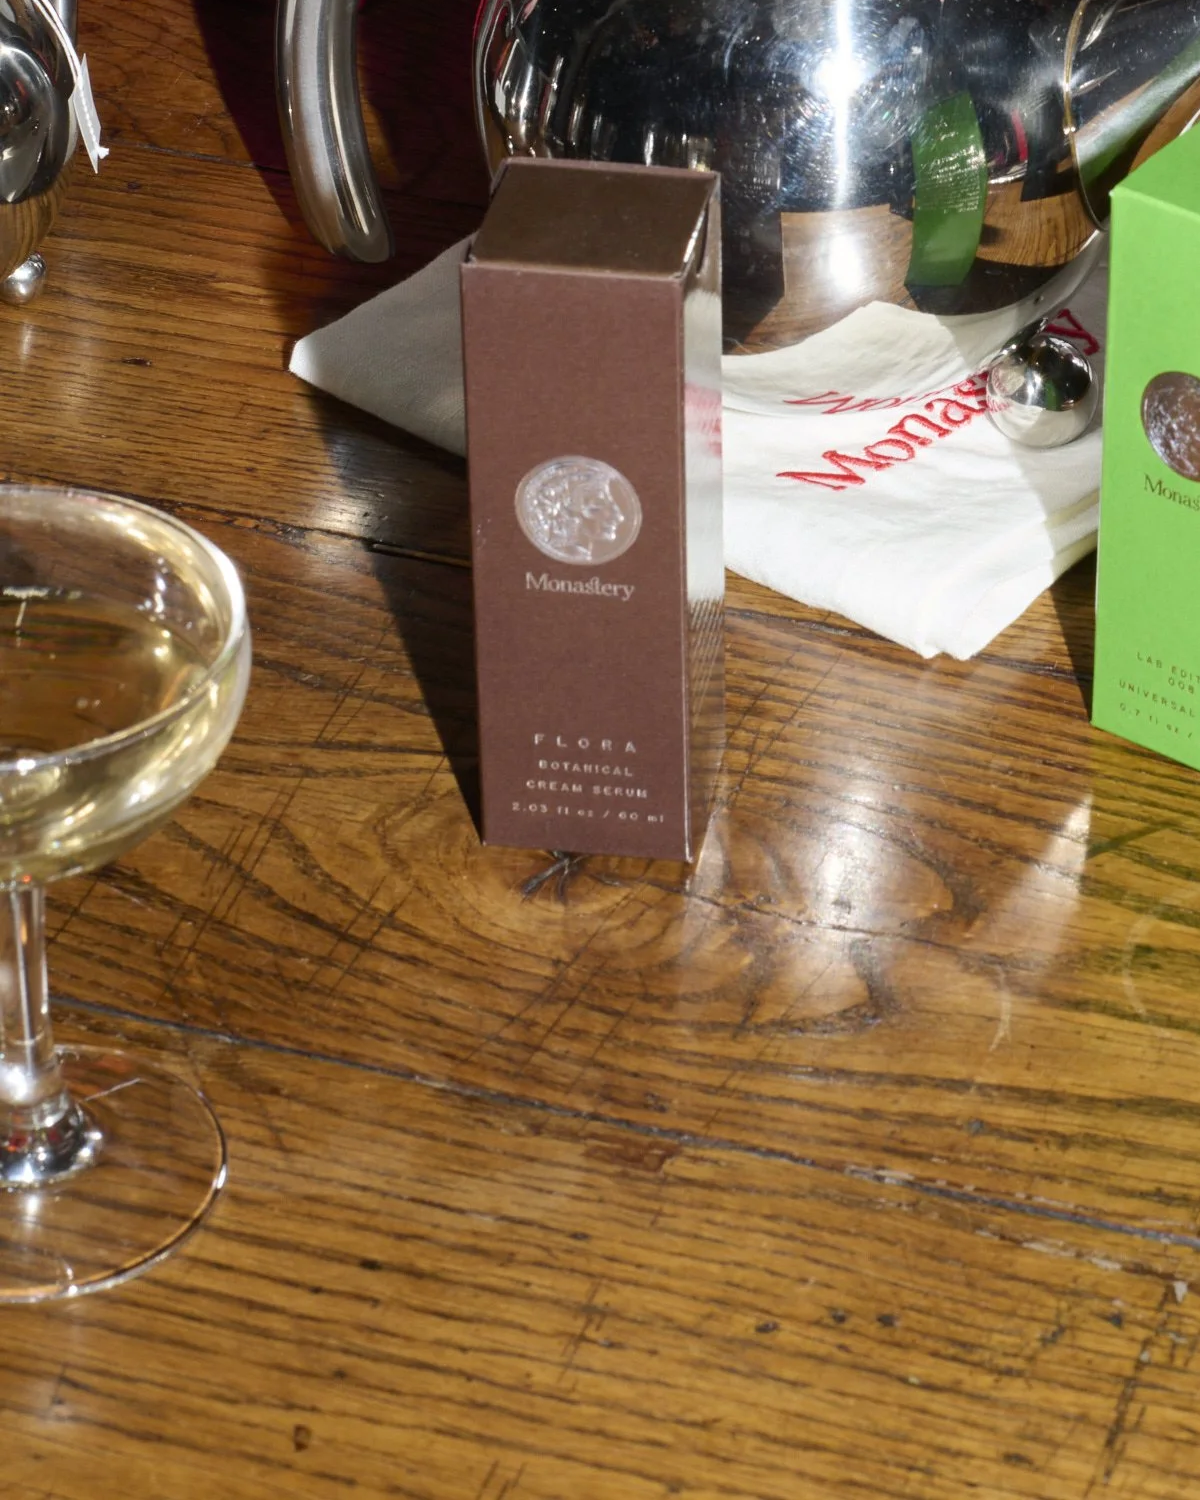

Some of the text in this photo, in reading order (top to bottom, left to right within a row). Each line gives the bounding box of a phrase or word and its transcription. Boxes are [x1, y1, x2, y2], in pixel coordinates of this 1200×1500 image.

[524, 571, 635, 601] Monastery
[1136, 651, 1163, 669] LAB
[1119, 679, 1196, 718] UNIVERSAL
[534, 733, 637, 753] FLORA
[538, 758, 633, 777] BOTANICAL
[526, 779, 648, 799] CREAM SERUM
[512, 801, 548, 814] 2.03
[556, 806, 569, 816] fl
[618, 811, 639, 821] 60
[647, 813, 665, 823] ml
